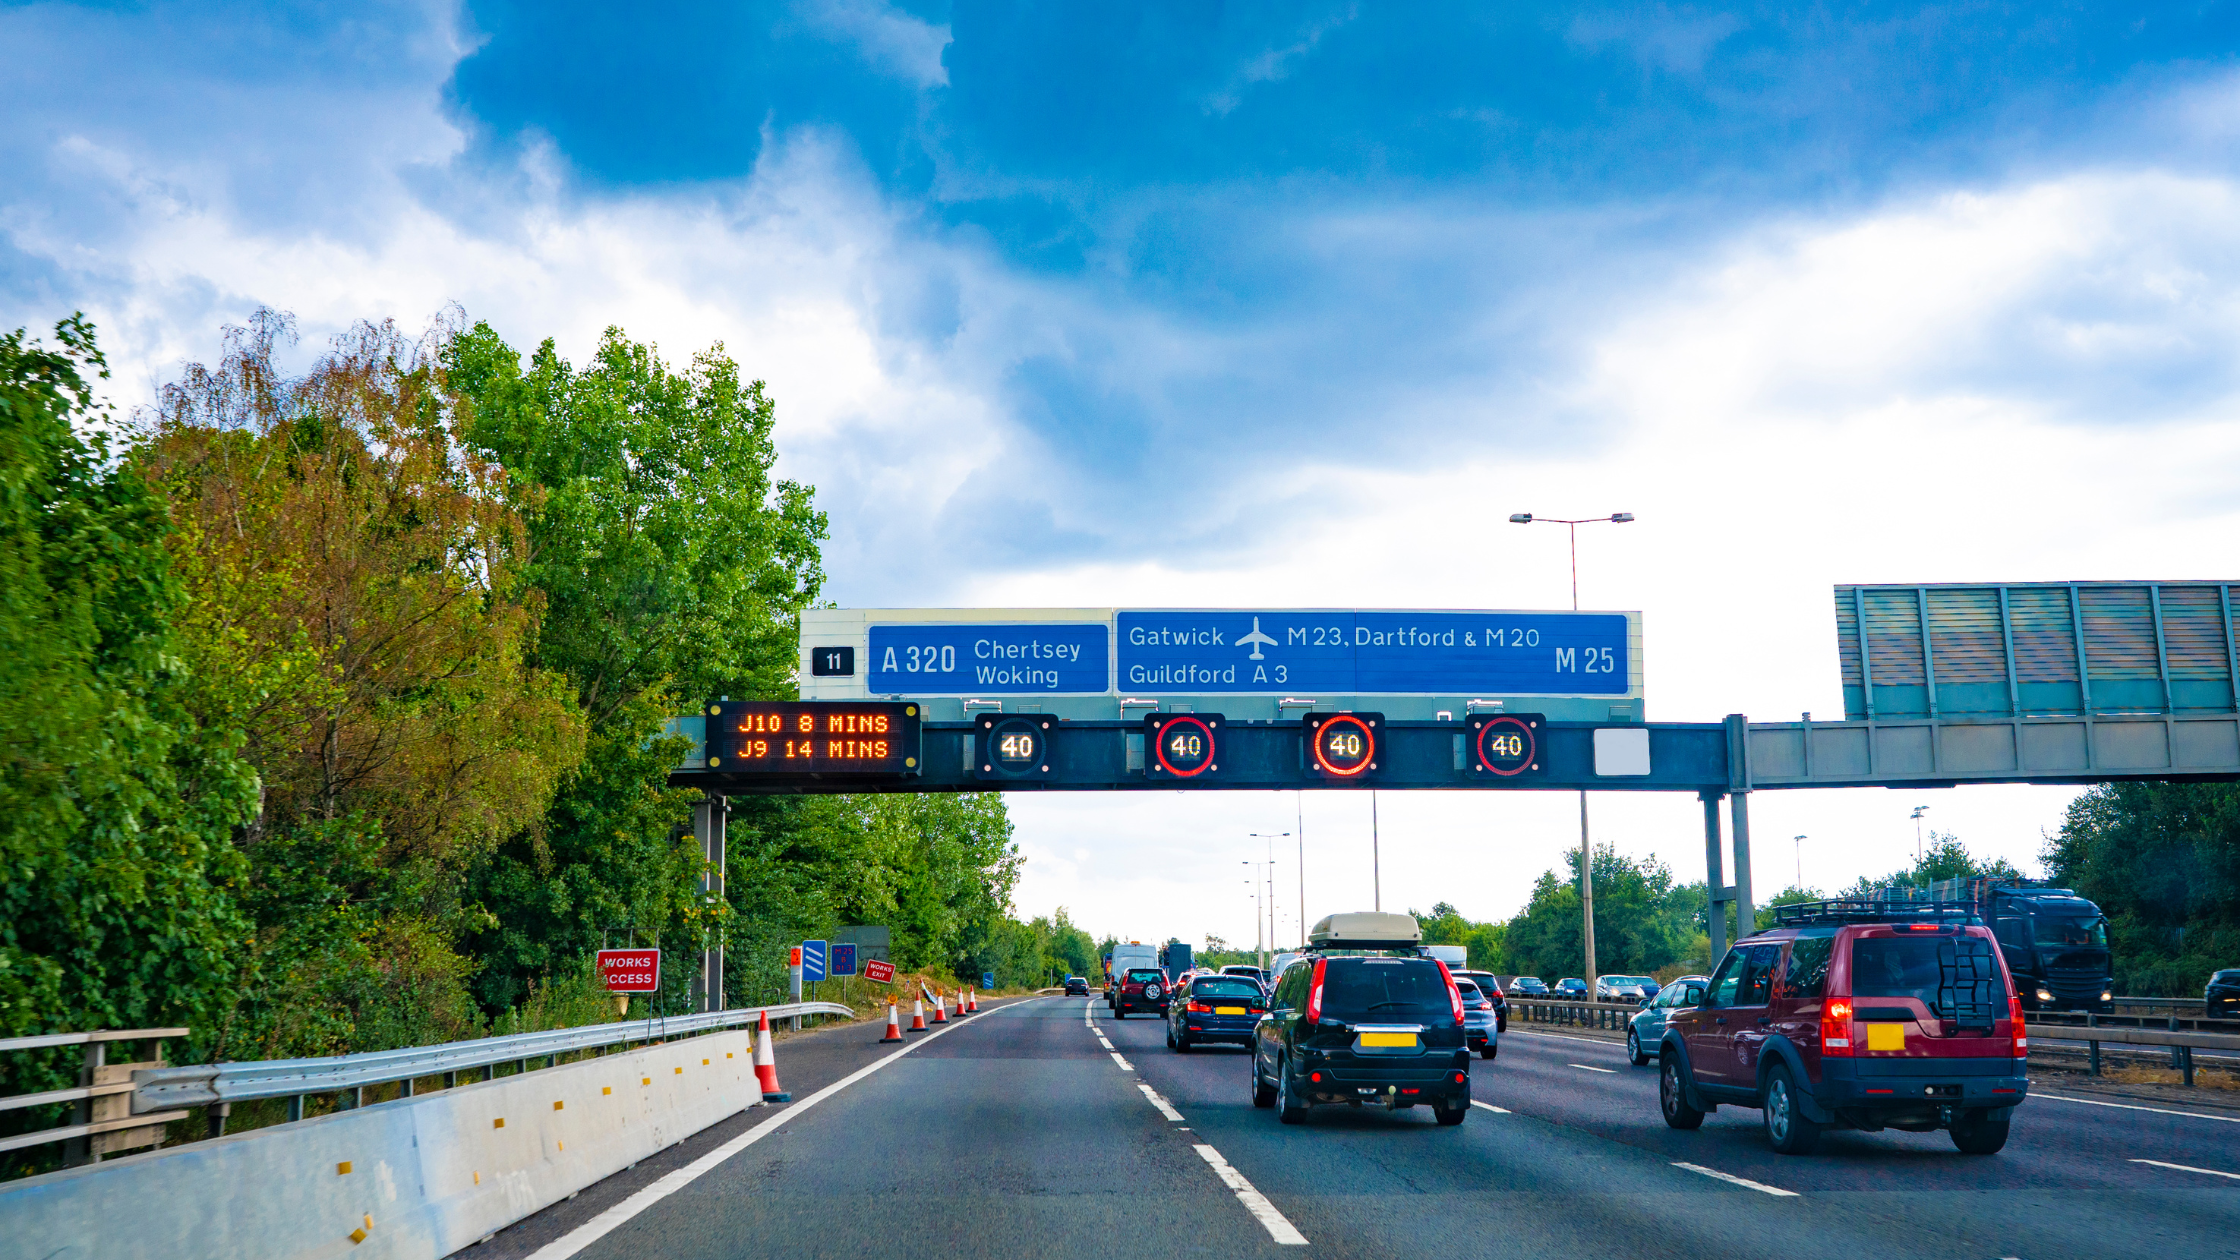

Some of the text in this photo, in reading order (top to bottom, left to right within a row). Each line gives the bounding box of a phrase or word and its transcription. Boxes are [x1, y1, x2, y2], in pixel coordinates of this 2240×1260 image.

[1129, 627, 1225, 646] Gatwick
[1355, 627, 1455, 647] Dartford
[1464, 631, 1477, 647] &
[906, 645, 956, 673] 320
[974, 639, 1081, 662] Chertsey
[826, 653, 841, 670] 11
[975, 666, 1059, 688] Woking
[1129, 664, 1235, 684] Guildford
[738, 714, 889, 733] J10 8 MINS
[738, 740, 889, 758] J9 14 MINS
[1001, 736, 1033, 757] 40
[1171, 735, 1201, 757] 40
[1329, 734, 1360, 756] 40
[1492, 735, 1522, 756] 40
[604, 957, 651, 968] WORKS
[870, 963, 892, 973] WORKS
[871, 970, 886, 979] EXIT
